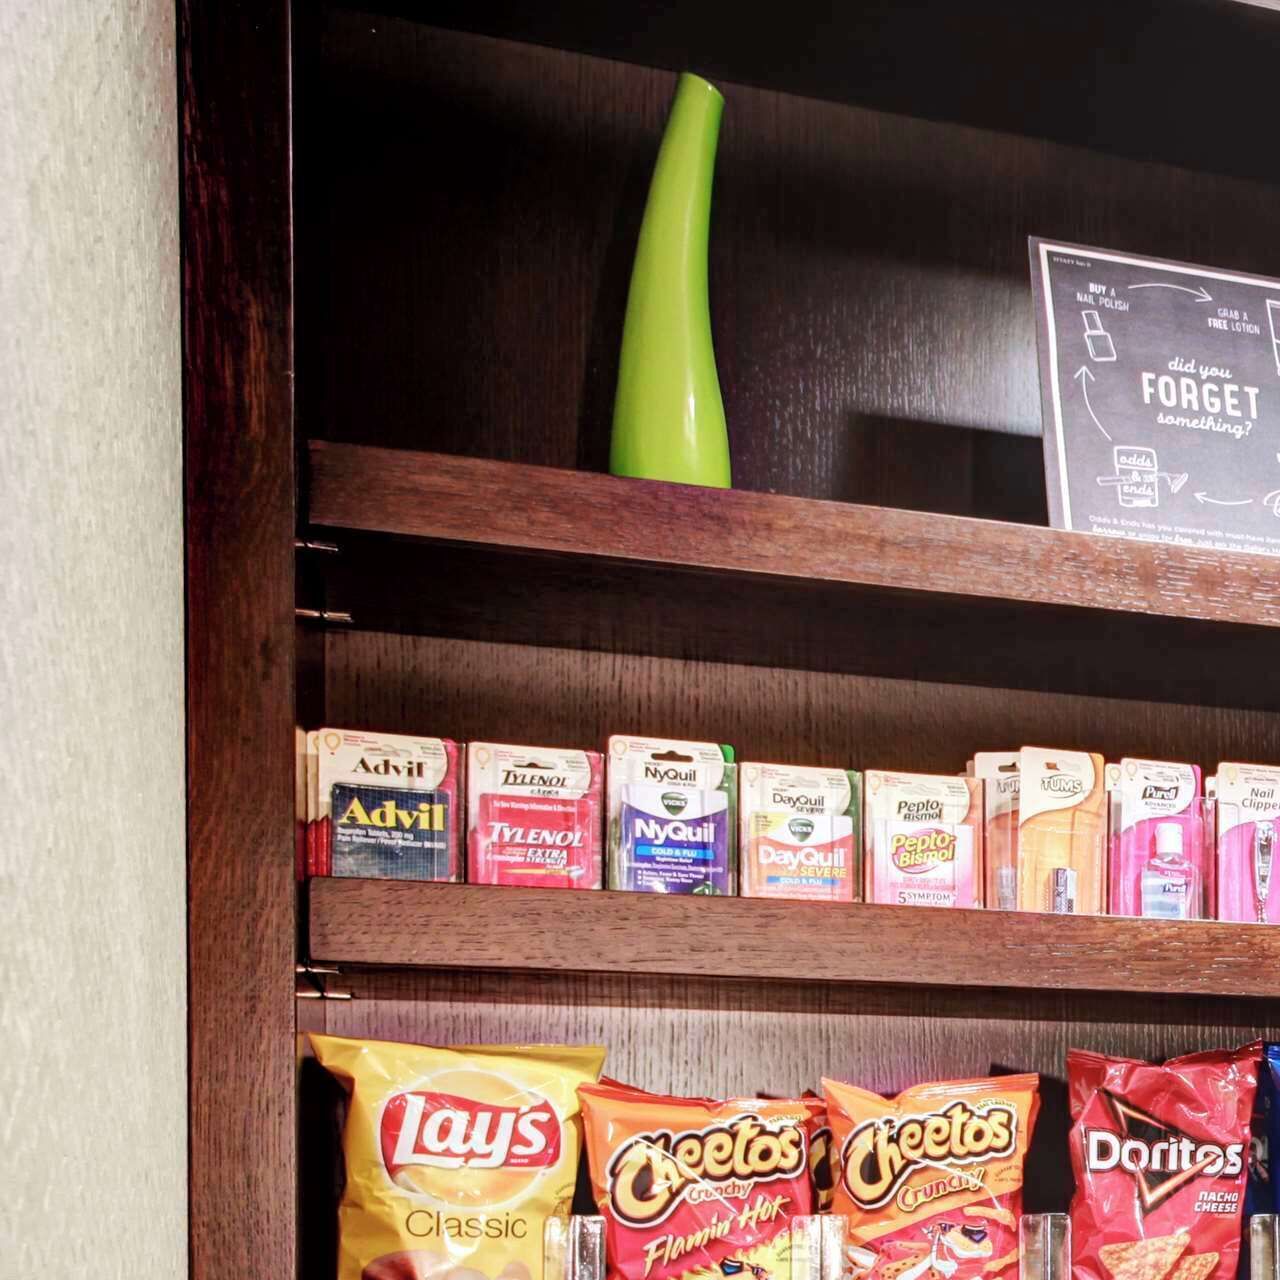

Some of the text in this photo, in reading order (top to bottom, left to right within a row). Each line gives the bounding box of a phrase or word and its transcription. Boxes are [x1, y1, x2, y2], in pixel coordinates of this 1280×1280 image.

[1089, 283, 1107, 295] BUY
[1077, 293, 1129, 312] NAIL POLISH
[1218, 307, 1239, 319] GRAB
[1208, 318, 1260, 335] FREE LOTION
[1168, 356, 1232, 379] did you
[1142, 372, 1259, 419] FORGET
[1157, 411, 1252, 438] something?
[1120, 453, 1152, 467] odds
[1122, 484, 1153, 497] ends
[352, 757, 424, 778] Advil
[645, 766, 697, 783] NyQuil
[502, 769, 568, 788] TYLENOL
[1041, 777, 1083, 794] TUMS
[773, 793, 825, 808] DayQuil
[1250, 787, 1275, 799] Nail
[338, 796, 445, 832] Advil
[904, 808, 943, 821] Bismol
[487, 821, 585, 848] TYLENOL
[635, 818, 716, 845] NyQuil
[527, 848, 568, 860] EXTRA
[759, 844, 845, 871] DayQuil
[899, 844, 956, 868] Bismol
[800, 866, 848, 878] SEVERE
[898, 892, 951, 904] 5 SYMPTOM
[393, 1092, 551, 1169] Lay's
[843, 1102, 1016, 1206] Cheetos
[1088, 1130, 1243, 1174] Doritos
[611, 1116, 803, 1224] Cheetos
[687, 1180, 753, 1203] Crunchy
[898, 1166, 985, 1210] Crunchy
[1198, 1191, 1239, 1202] NACHO
[1194, 1202, 1238, 1213] CHEESE
[405, 1210, 528, 1239] Classic
[643, 1195, 792, 1277] Flamin' Hot
